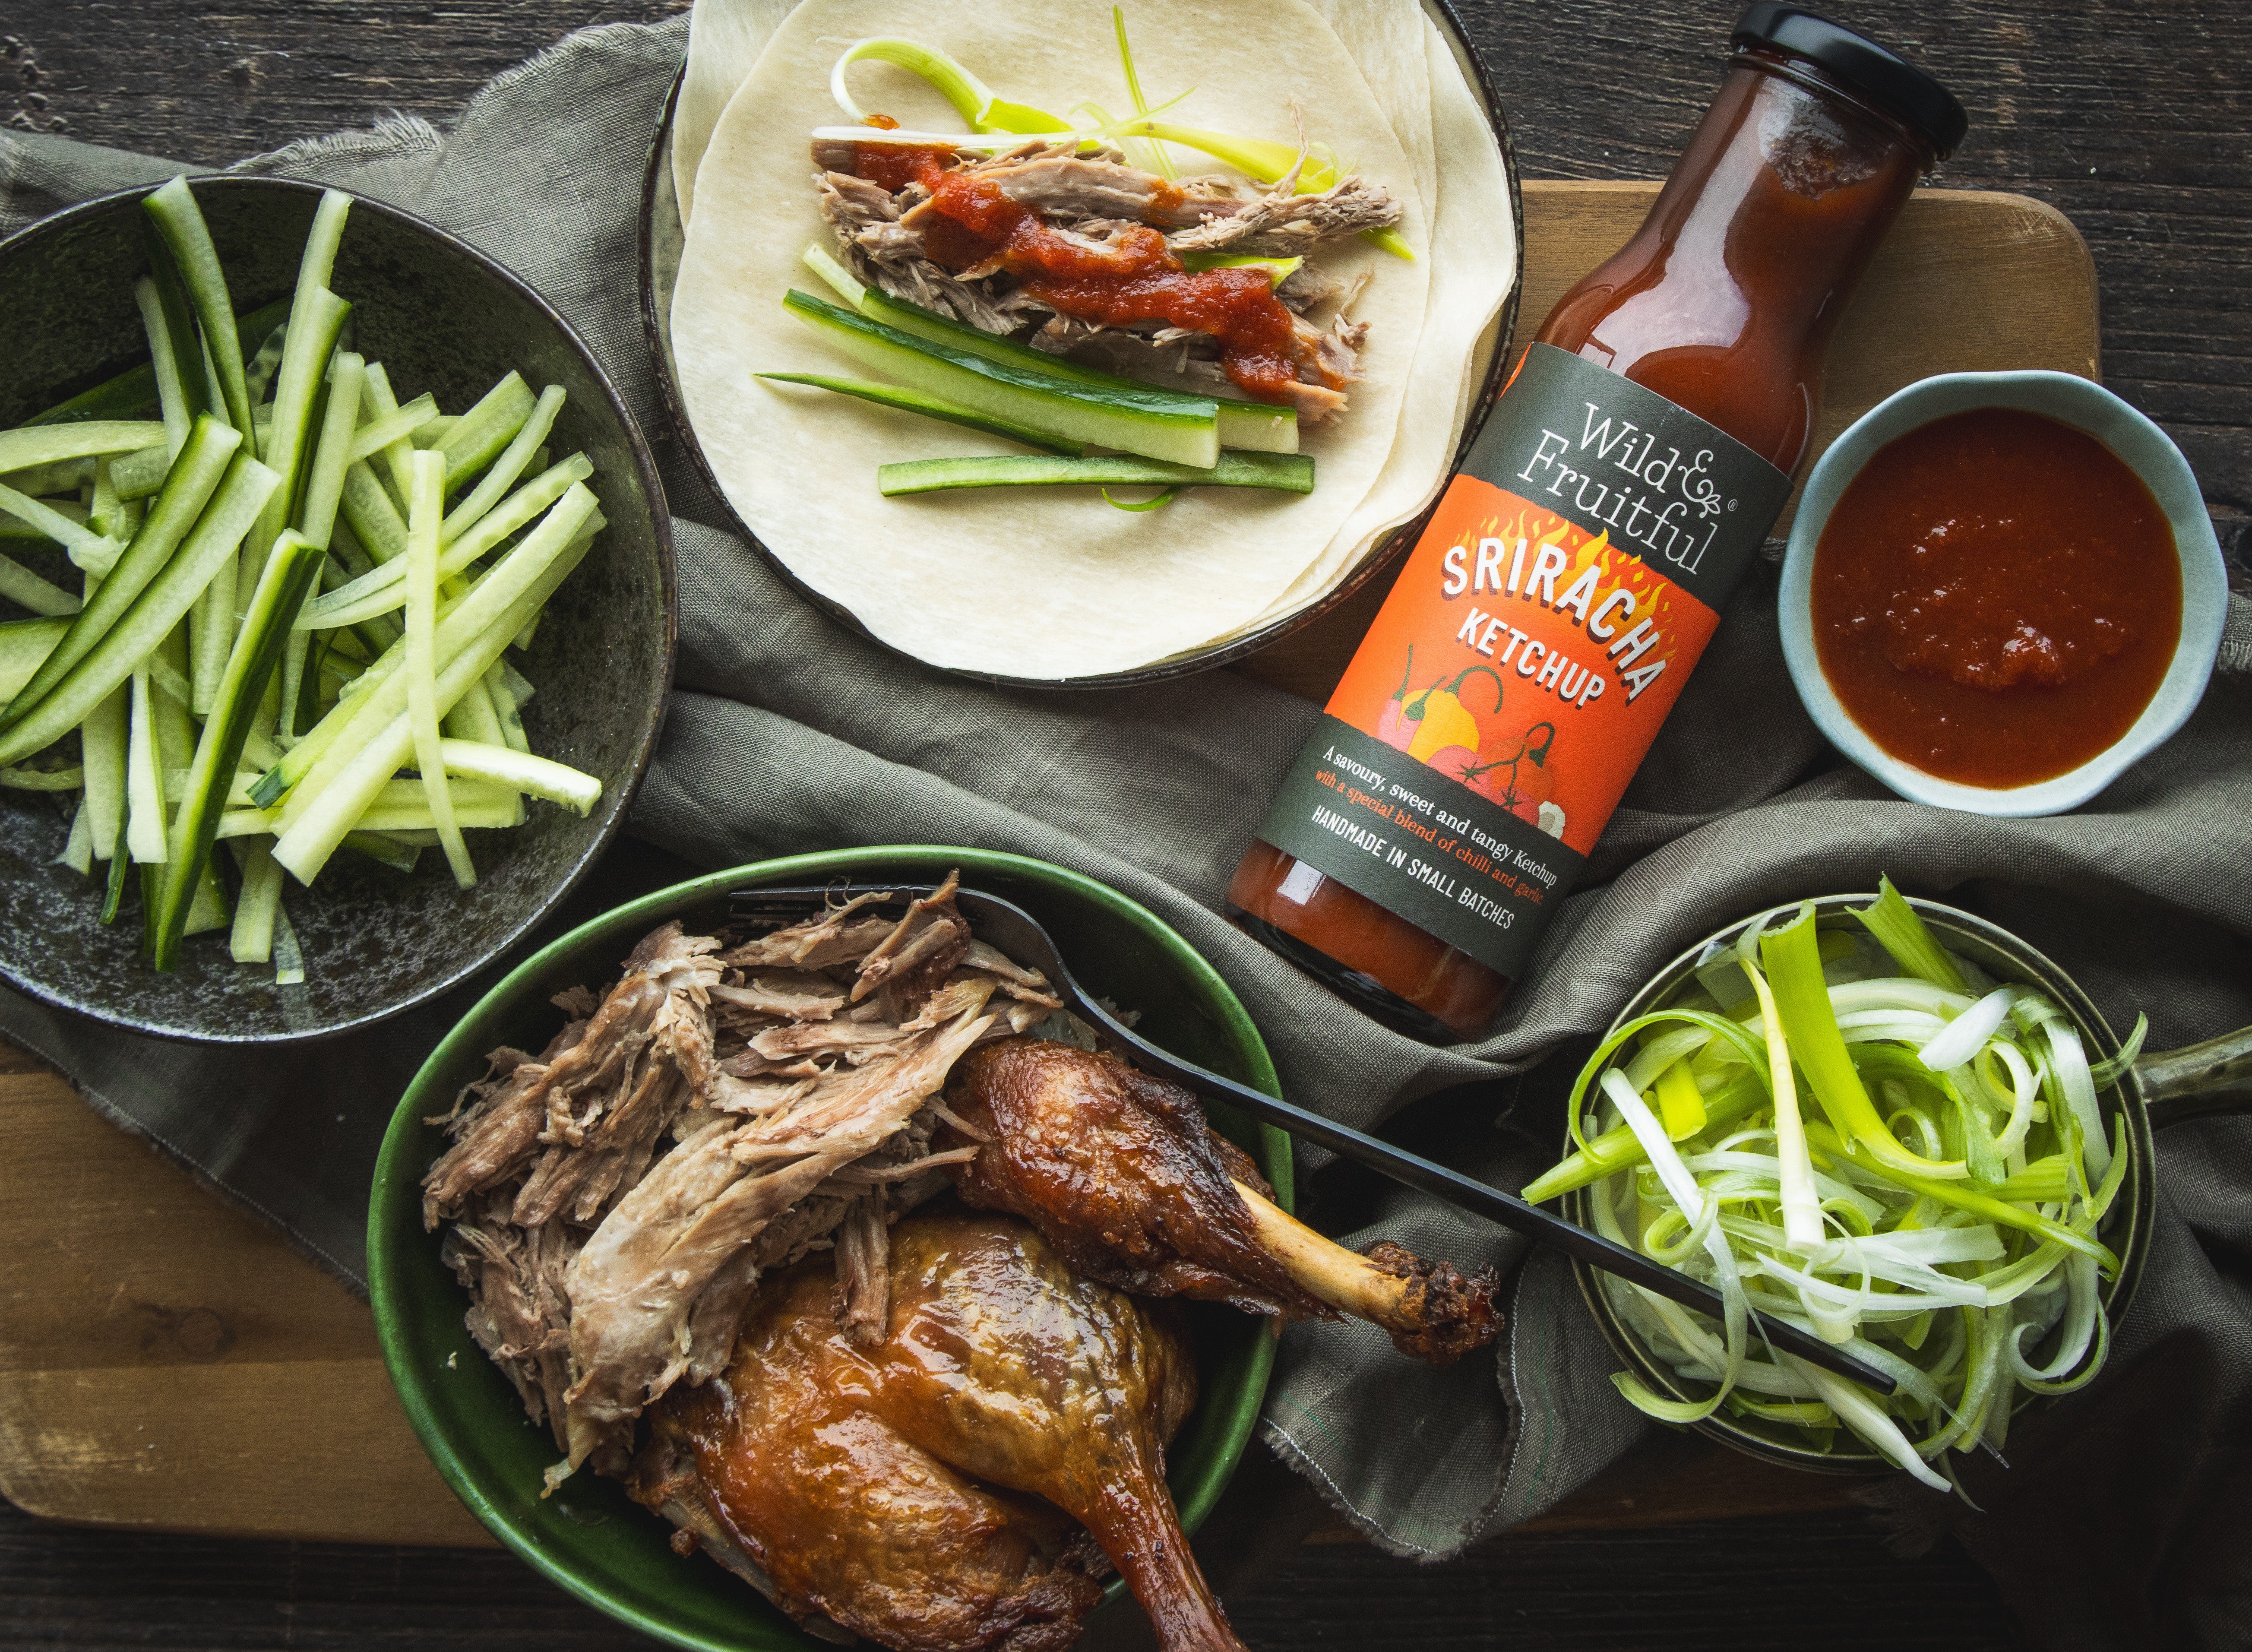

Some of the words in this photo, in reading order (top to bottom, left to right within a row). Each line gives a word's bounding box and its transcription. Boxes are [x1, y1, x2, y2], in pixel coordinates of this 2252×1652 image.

[1517, 429, 1717, 575] Fruitful
[1580, 402, 1680, 493] Wild
[1441, 538, 1667, 706] SRIRACHA
[1455, 607, 1606, 710] KETCHUP
[1311, 805, 1388, 857] HANDMADE
[1386, 846, 1408, 868] IN
[1408, 859, 1456, 898] SMALL
[1458, 887, 1514, 929] BATCHES
[1316, 770, 1337, 788] with
[1337, 782, 1346, 794] a
[1347, 788, 1394, 819] special
[1395, 809, 1437, 842] blend
[1438, 835, 1457, 853] of
[1456, 847, 1492, 874] chilli
[1492, 868, 1518, 888] and
[1515, 883, 1543, 904] garlic.
[1323, 746, 1335, 760] A
[1335, 754, 1385, 791] savoury,
[1390, 784, 1435, 815] sweet
[1436, 809, 1471, 835] and
[1471, 827, 1512, 862] tangy
[1512, 849, 1556, 889] Ketchup
